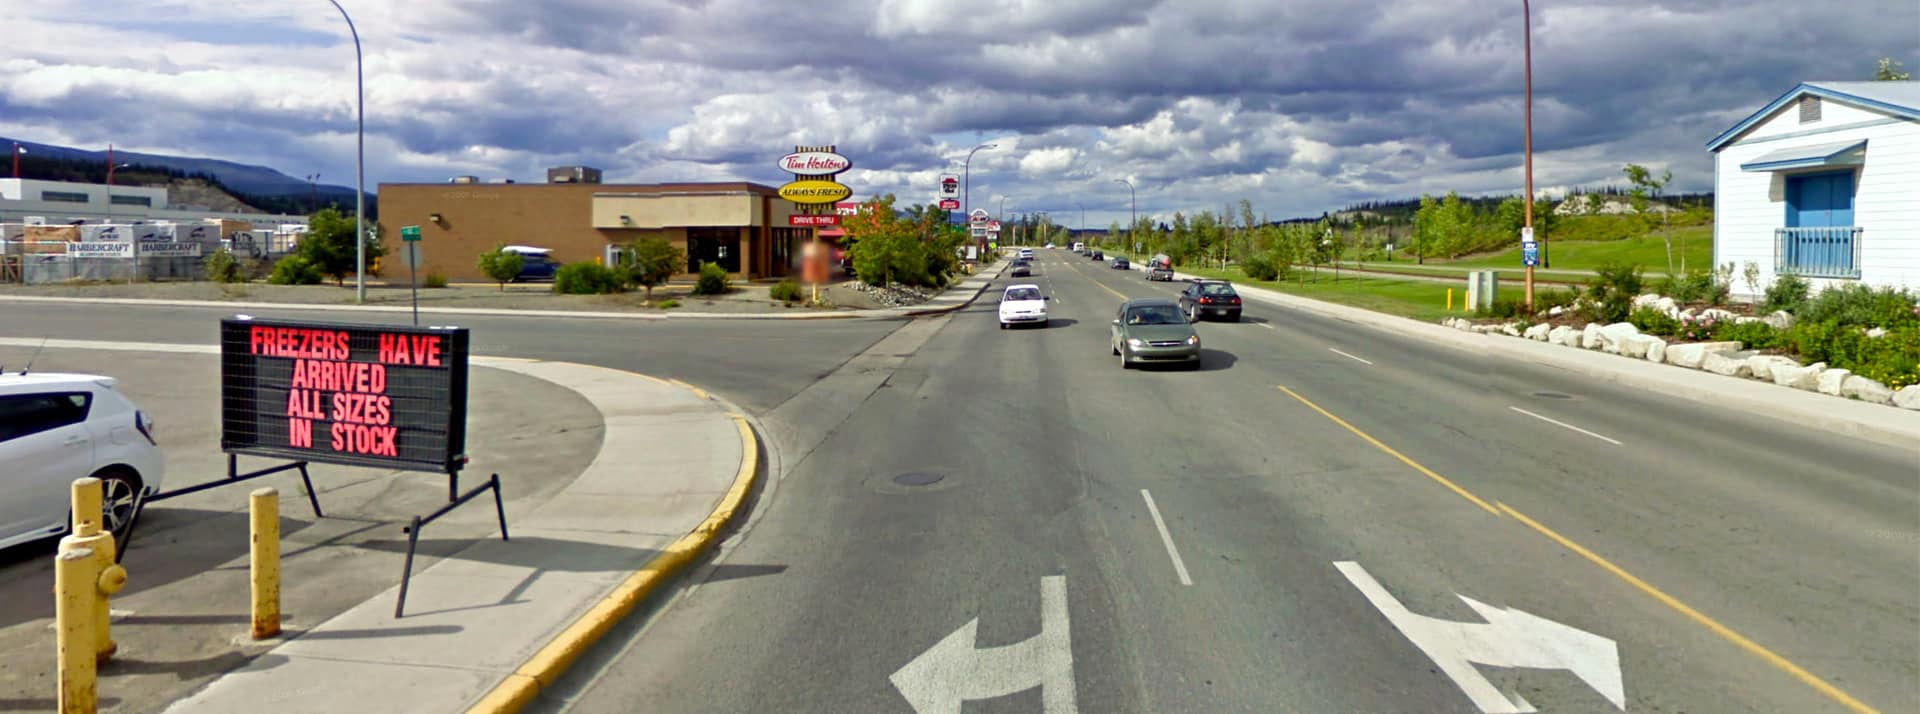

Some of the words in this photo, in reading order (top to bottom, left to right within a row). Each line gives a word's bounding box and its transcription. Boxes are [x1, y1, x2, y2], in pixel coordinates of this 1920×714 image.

[786, 156, 805, 169] Tim
[806, 156, 846, 169] Hortons
[783, 188, 815, 196] ALWAYS
[816, 188, 847, 196] FRESH
[793, 216, 814, 224] DRIVE
[816, 216, 834, 224] THRU
[250, 326, 349, 360] FREEZERS
[379, 333, 441, 367] HAVE
[292, 359, 386, 393] ARRIVED
[287, 389, 325, 419] ALL
[333, 392, 390, 425] SIZES
[289, 418, 312, 448] IN
[331, 425, 397, 456] STOCK
